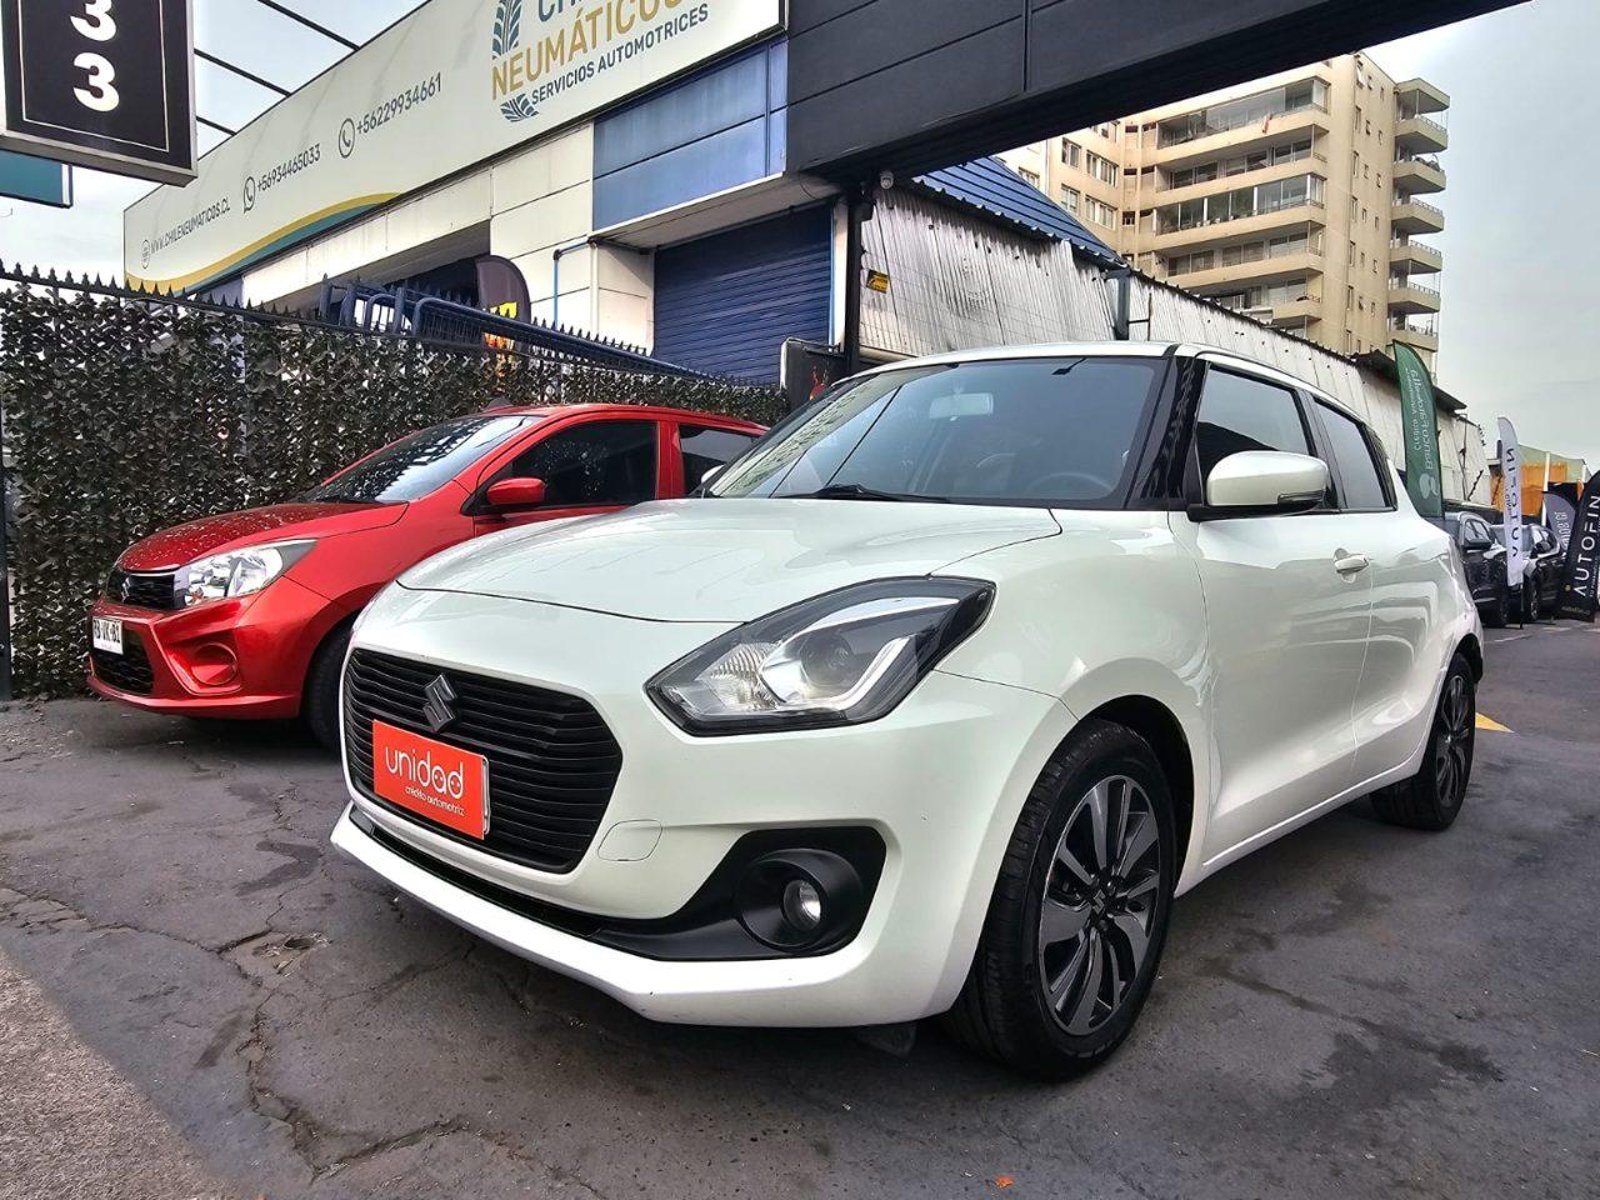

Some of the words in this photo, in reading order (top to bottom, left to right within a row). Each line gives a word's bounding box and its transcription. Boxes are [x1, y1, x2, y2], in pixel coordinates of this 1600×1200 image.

[491, 0, 688, 100] NEUMÁTICO
[531, 62, 595, 105] SERVICIOS
[597, 3, 708, 73] AUTOMOTRICES
[356, 71, 441, 135] +56229934661
[257, 143, 321, 192] +56934465033
[1574, 495, 1600, 597] AUTOFIN
[384, 746, 464, 799] unidad
